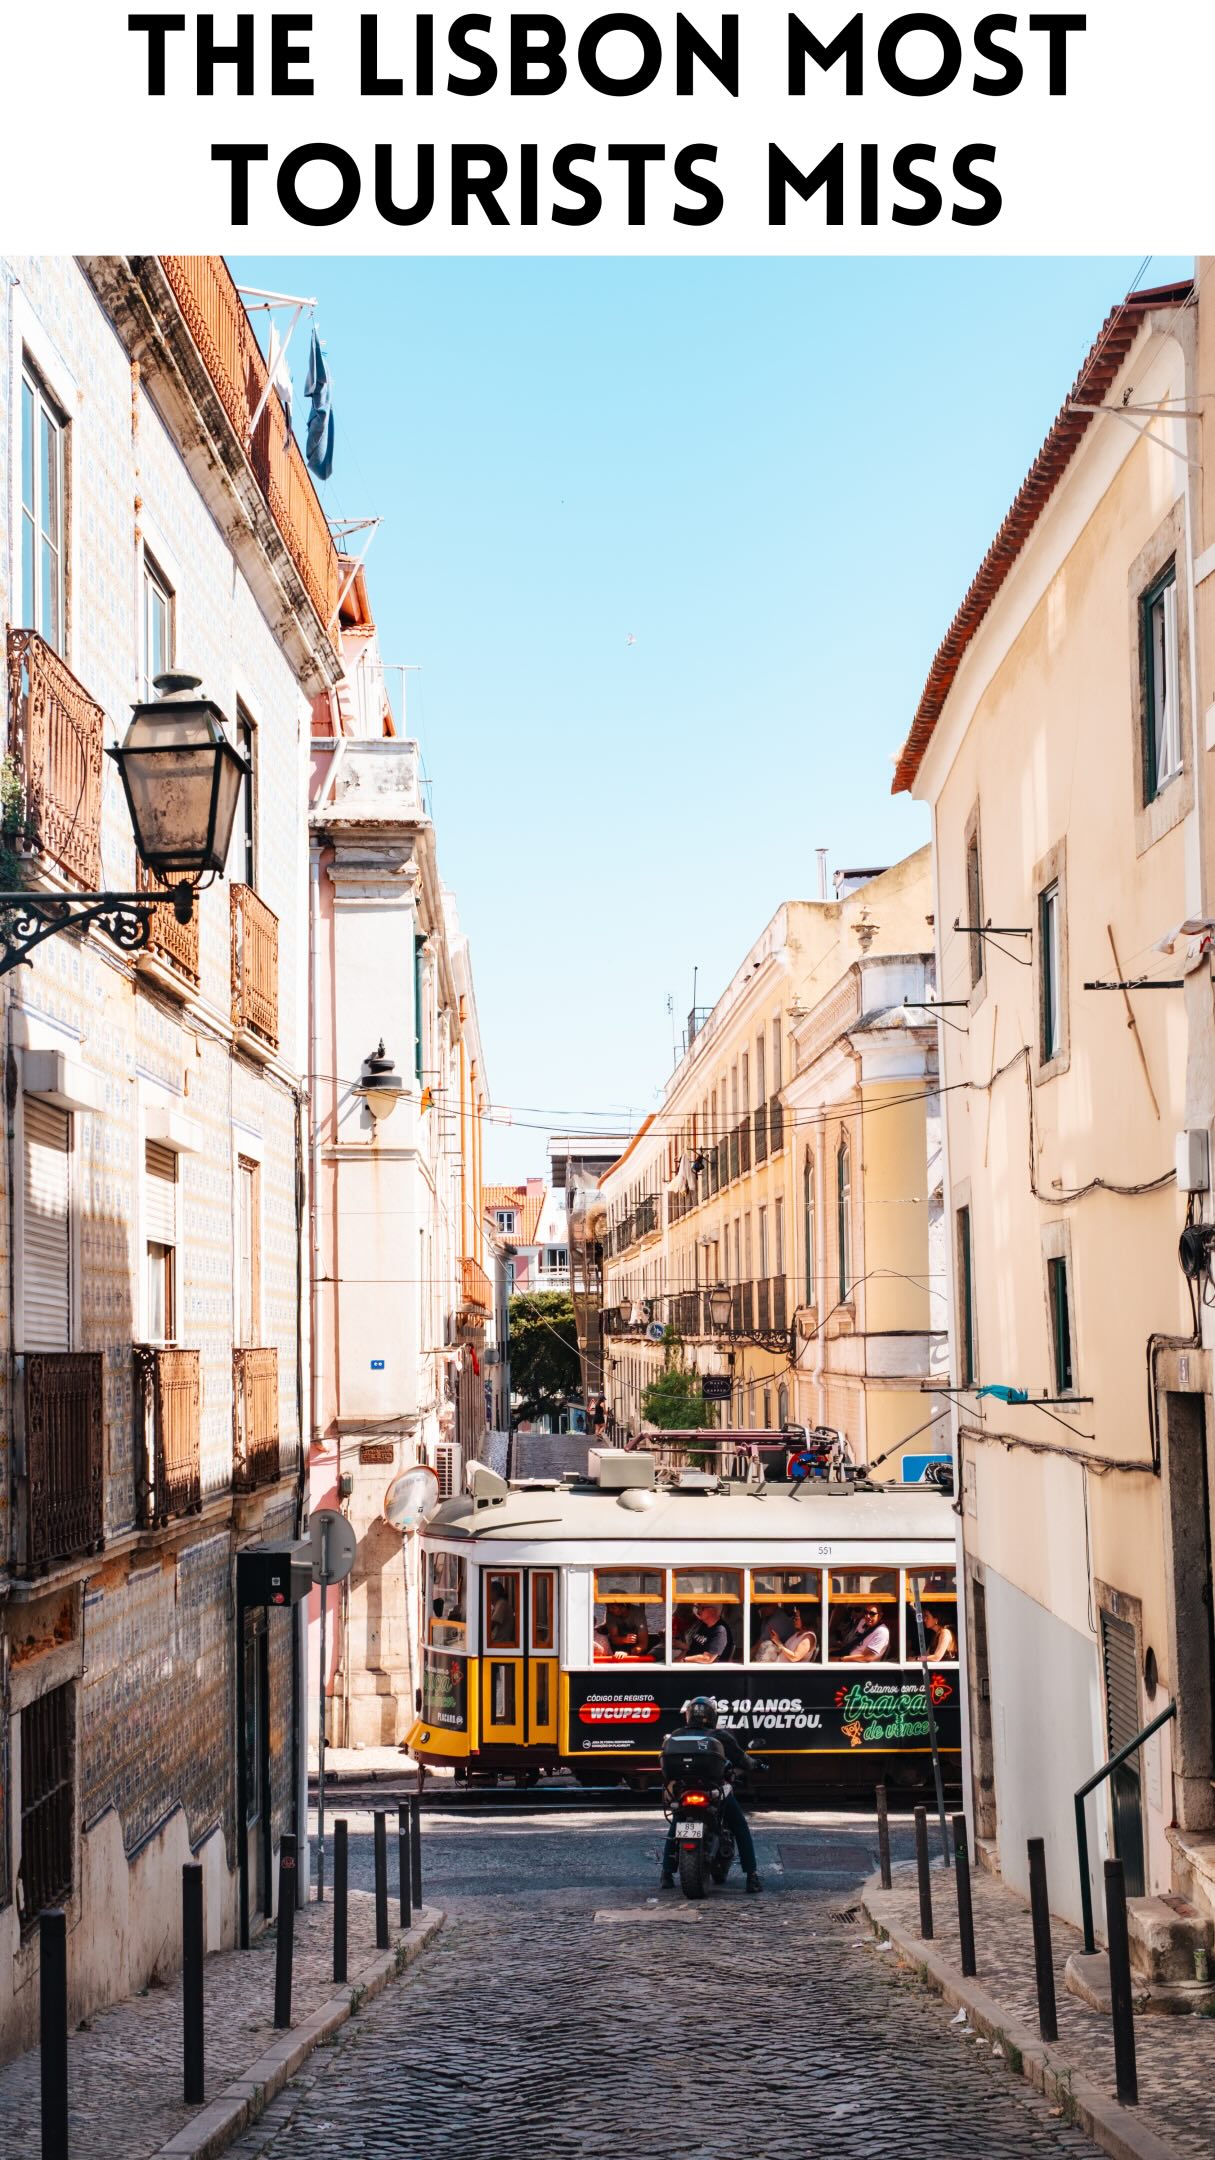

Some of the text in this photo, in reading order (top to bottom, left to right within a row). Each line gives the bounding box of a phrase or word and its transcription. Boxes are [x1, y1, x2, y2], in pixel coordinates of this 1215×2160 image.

[818, 1546, 832, 1555] 551
[901, 1685, 918, 1693] com
[586, 1694, 613, 1702] CÓDIGO
[732, 1699, 751, 1714] 10
[752, 1698, 805, 1714] ANOS,
[590, 1707, 651, 1719] WCUP20
[716, 1714, 823, 1729] ELA VOLTOU.
[864, 1720, 884, 1741] de
[685, 1823, 695, 1831] 89
[692, 1830, 702, 1838] 76
